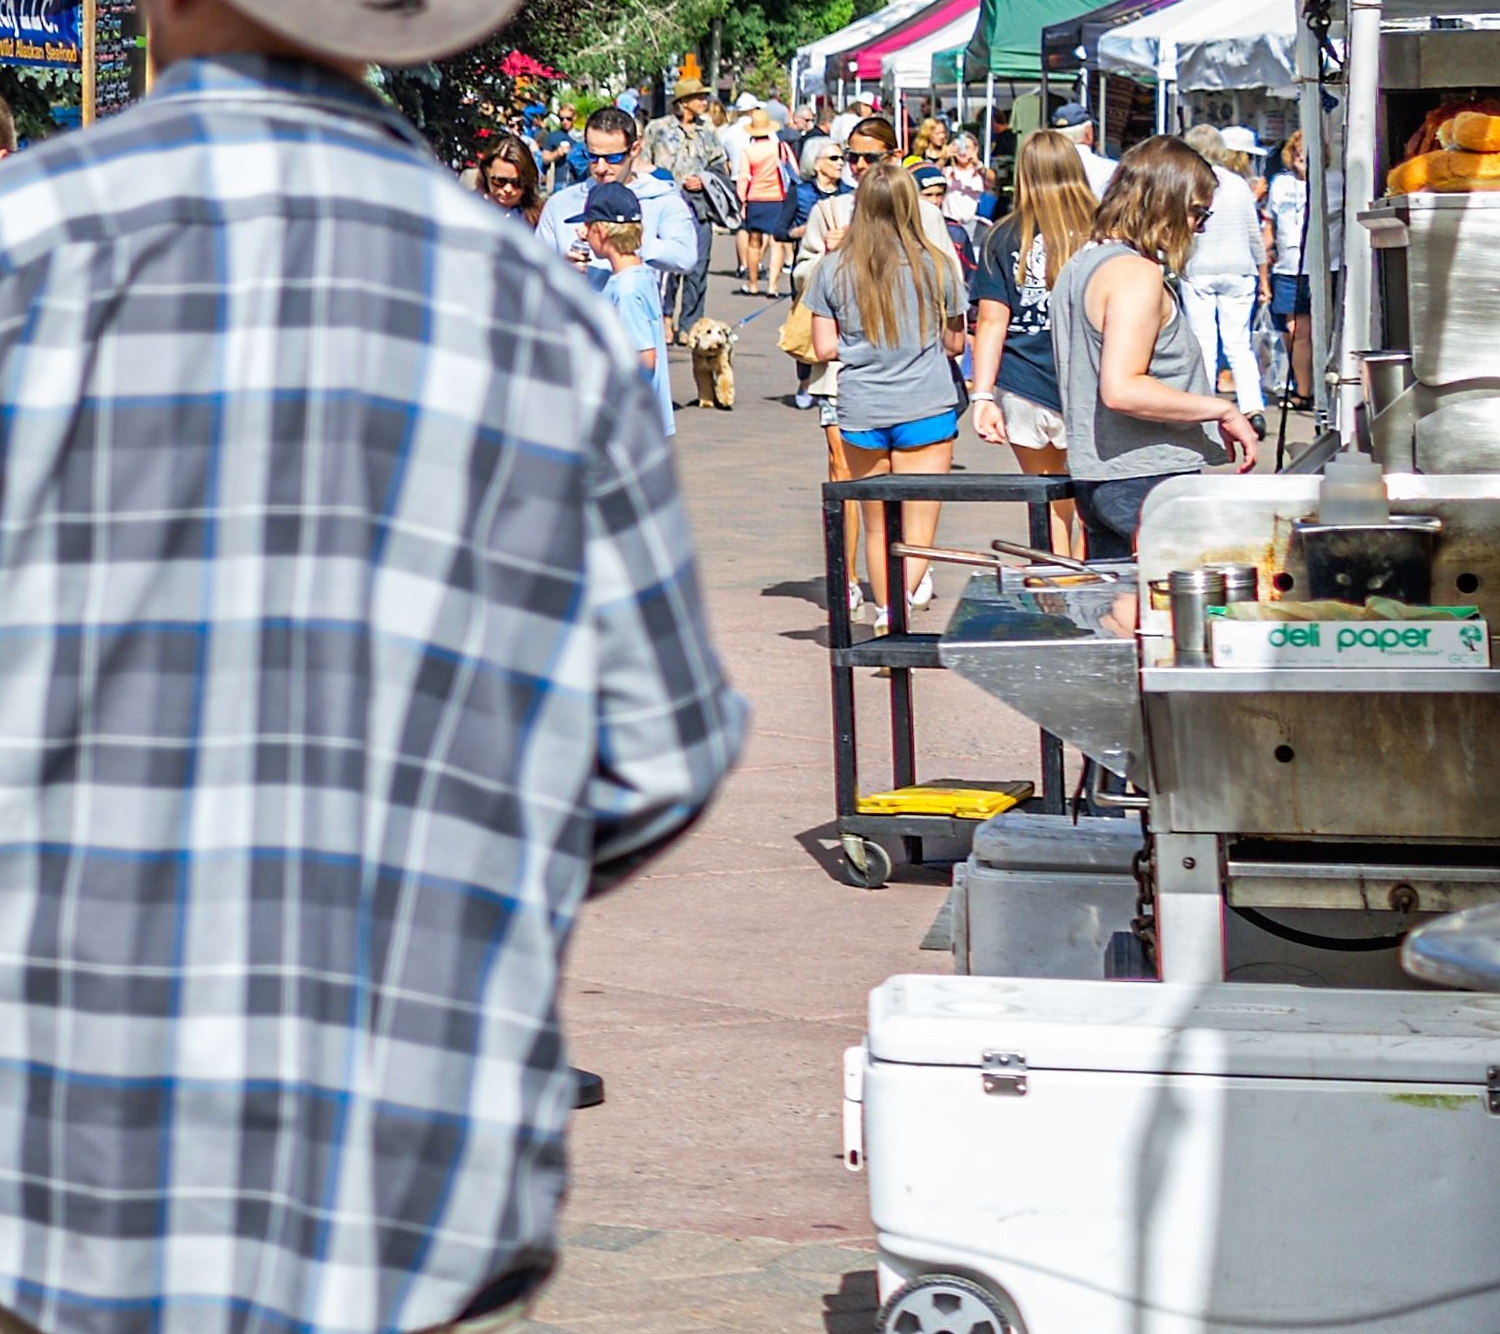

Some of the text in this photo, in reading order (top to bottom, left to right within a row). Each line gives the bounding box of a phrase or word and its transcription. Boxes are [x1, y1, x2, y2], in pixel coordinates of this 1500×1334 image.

[15, 40, 45, 60] Alaskan
[45, 41, 77, 63] Seafood
[1269, 622, 1432, 653] deli paper
